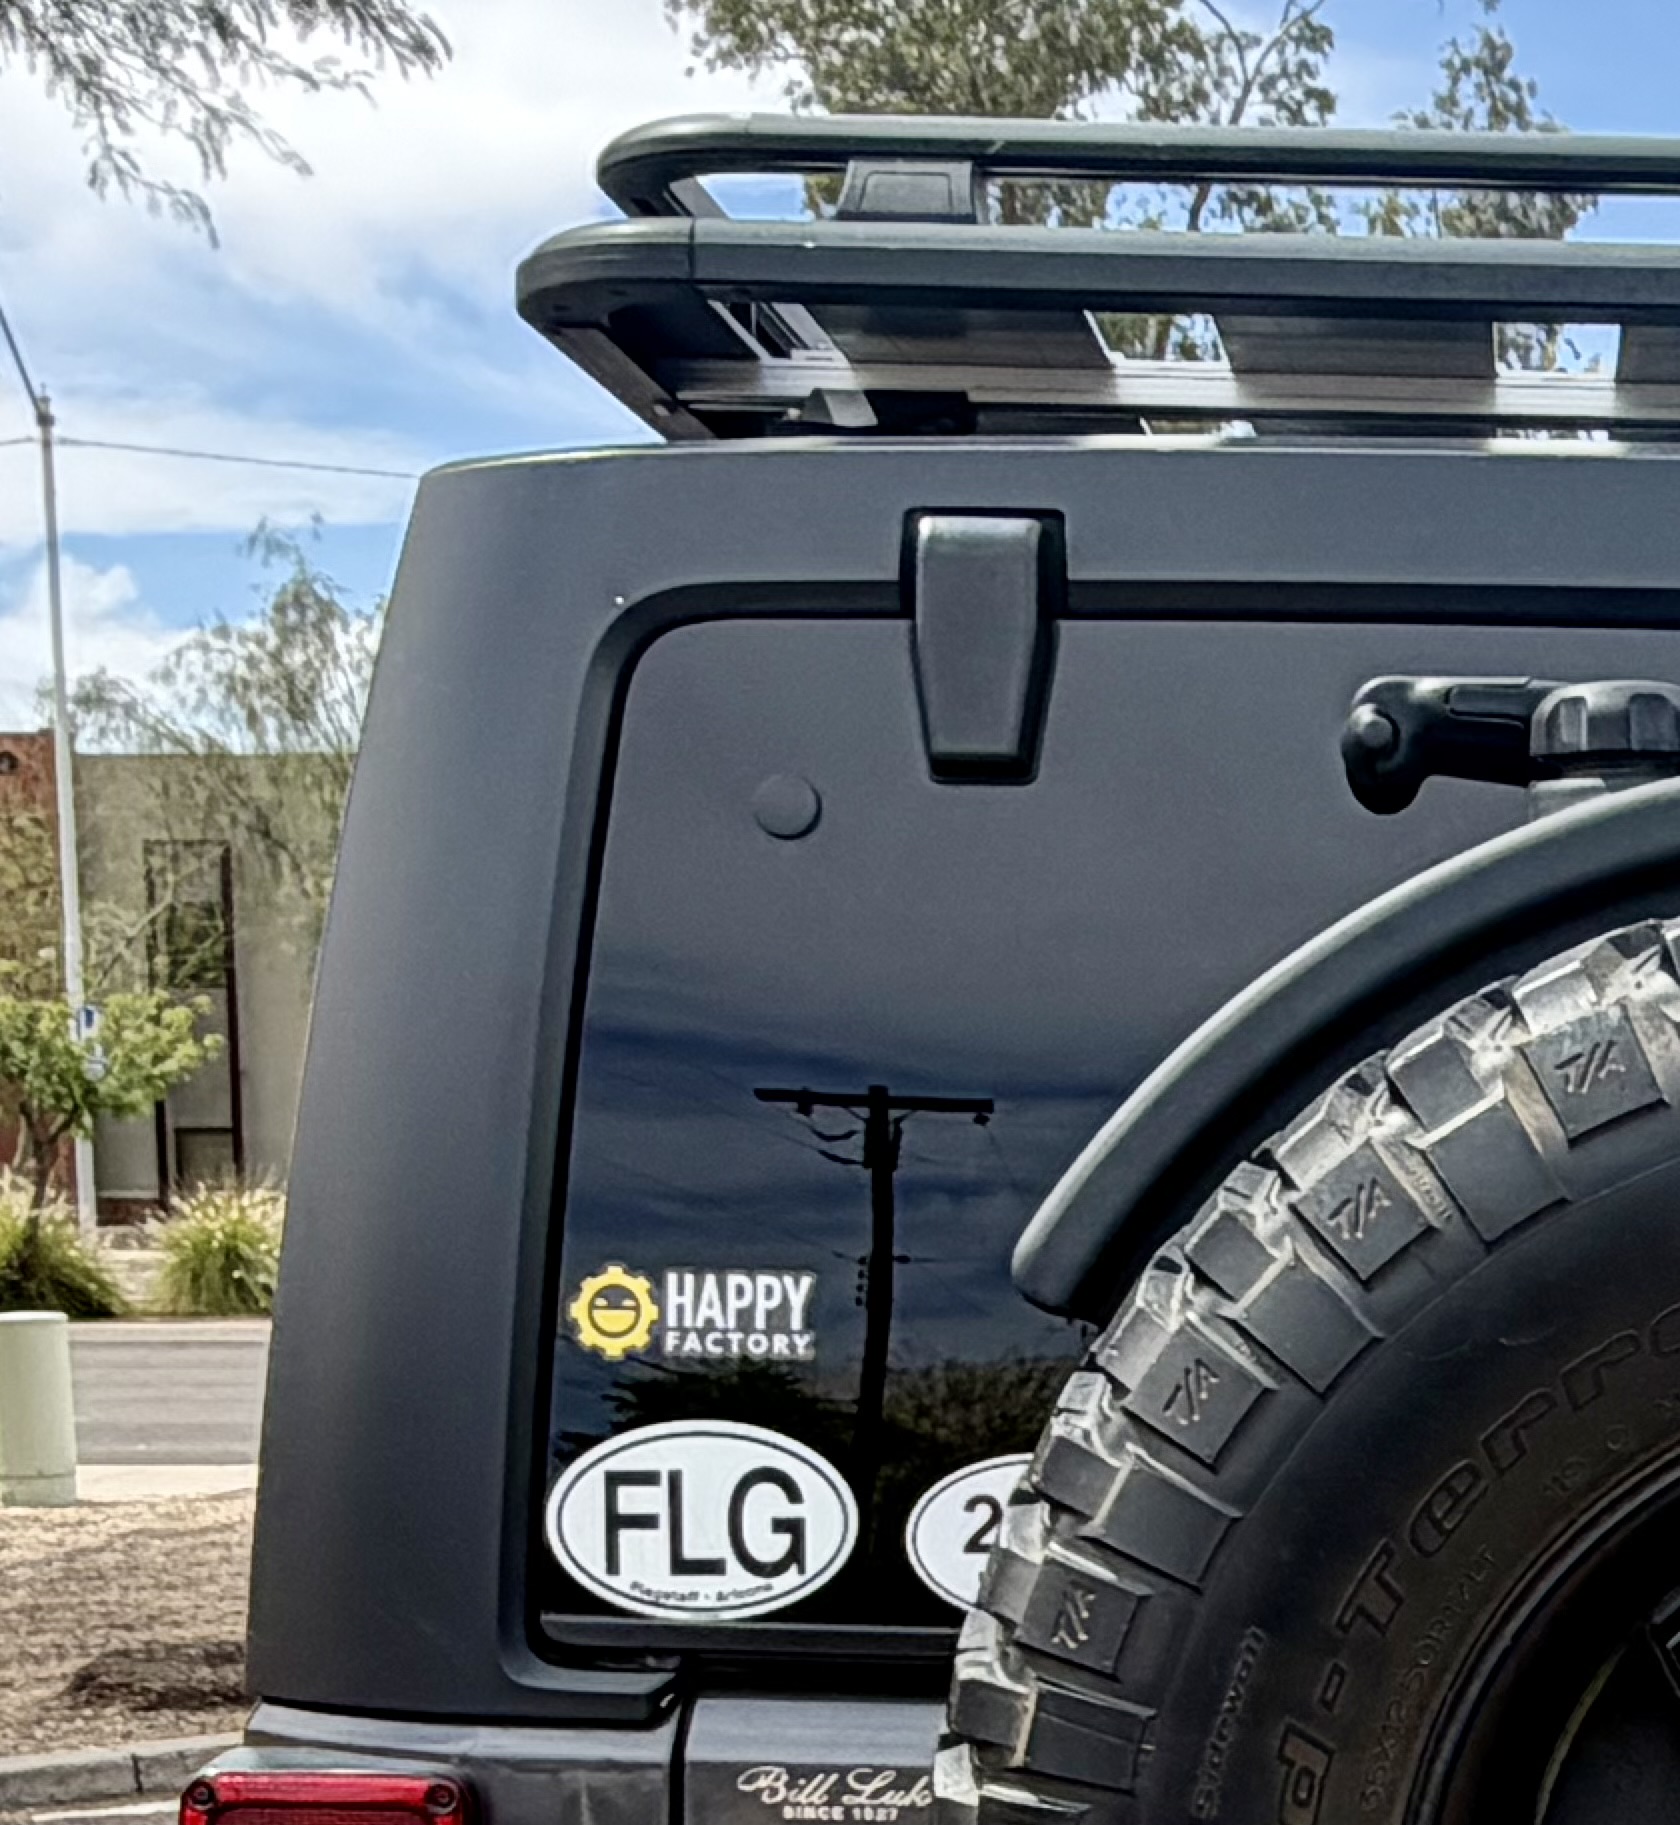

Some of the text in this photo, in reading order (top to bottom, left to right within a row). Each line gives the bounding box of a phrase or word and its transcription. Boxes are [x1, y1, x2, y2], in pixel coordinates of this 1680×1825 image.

[666, 1273, 812, 1331] HAPPY
[665, 1332, 812, 1357] FACTORY
[604, 1466, 806, 1579] FLG
[737, 1766, 933, 1806] Bill Luk
[782, 1806, 845, 1821] SINCE
